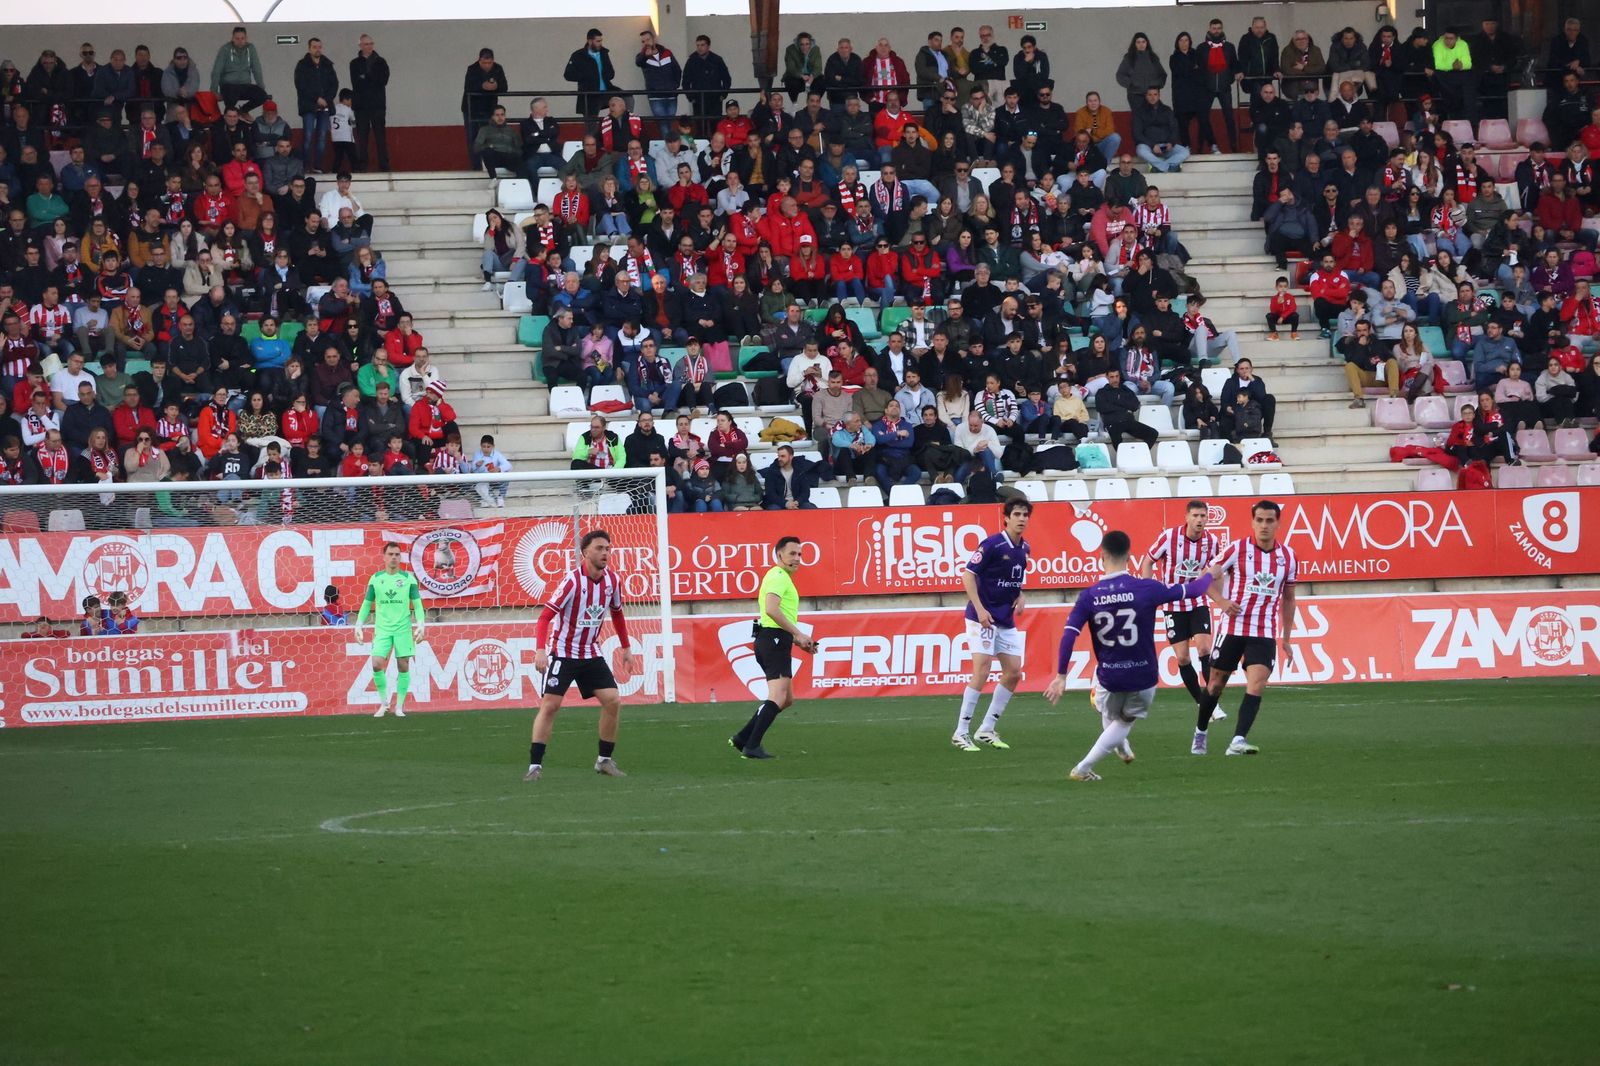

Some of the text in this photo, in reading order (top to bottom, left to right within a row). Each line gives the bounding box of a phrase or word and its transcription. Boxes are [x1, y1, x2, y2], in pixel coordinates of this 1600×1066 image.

[1542, 500, 1568, 541] 8
[883, 511, 988, 561] fisio
[1509, 521, 1553, 570] ZAMORA
[692, 536, 821, 570] ÓPTIO
[257, 529, 365, 609] CF
[1296, 558, 1391, 576] TAMIENTO
[422, 574, 473, 591] MODORRO
[886, 577, 963, 587] POLICLÍNIC
[1040, 573, 1089, 585] PODOLOGÍA
[1093, 592, 1134, 606] J.CASADO
[980, 628, 994, 640] 20
[1094, 607, 1139, 648] 23
[67, 646, 164, 665] bodegas
[24, 648, 296, 699] Sumiller
[1342, 656, 1392, 681] S.L.
[812, 675, 918, 688] REFRIGERACION
[26, 698, 298, 720] www.bodegasdelsumiller.com
